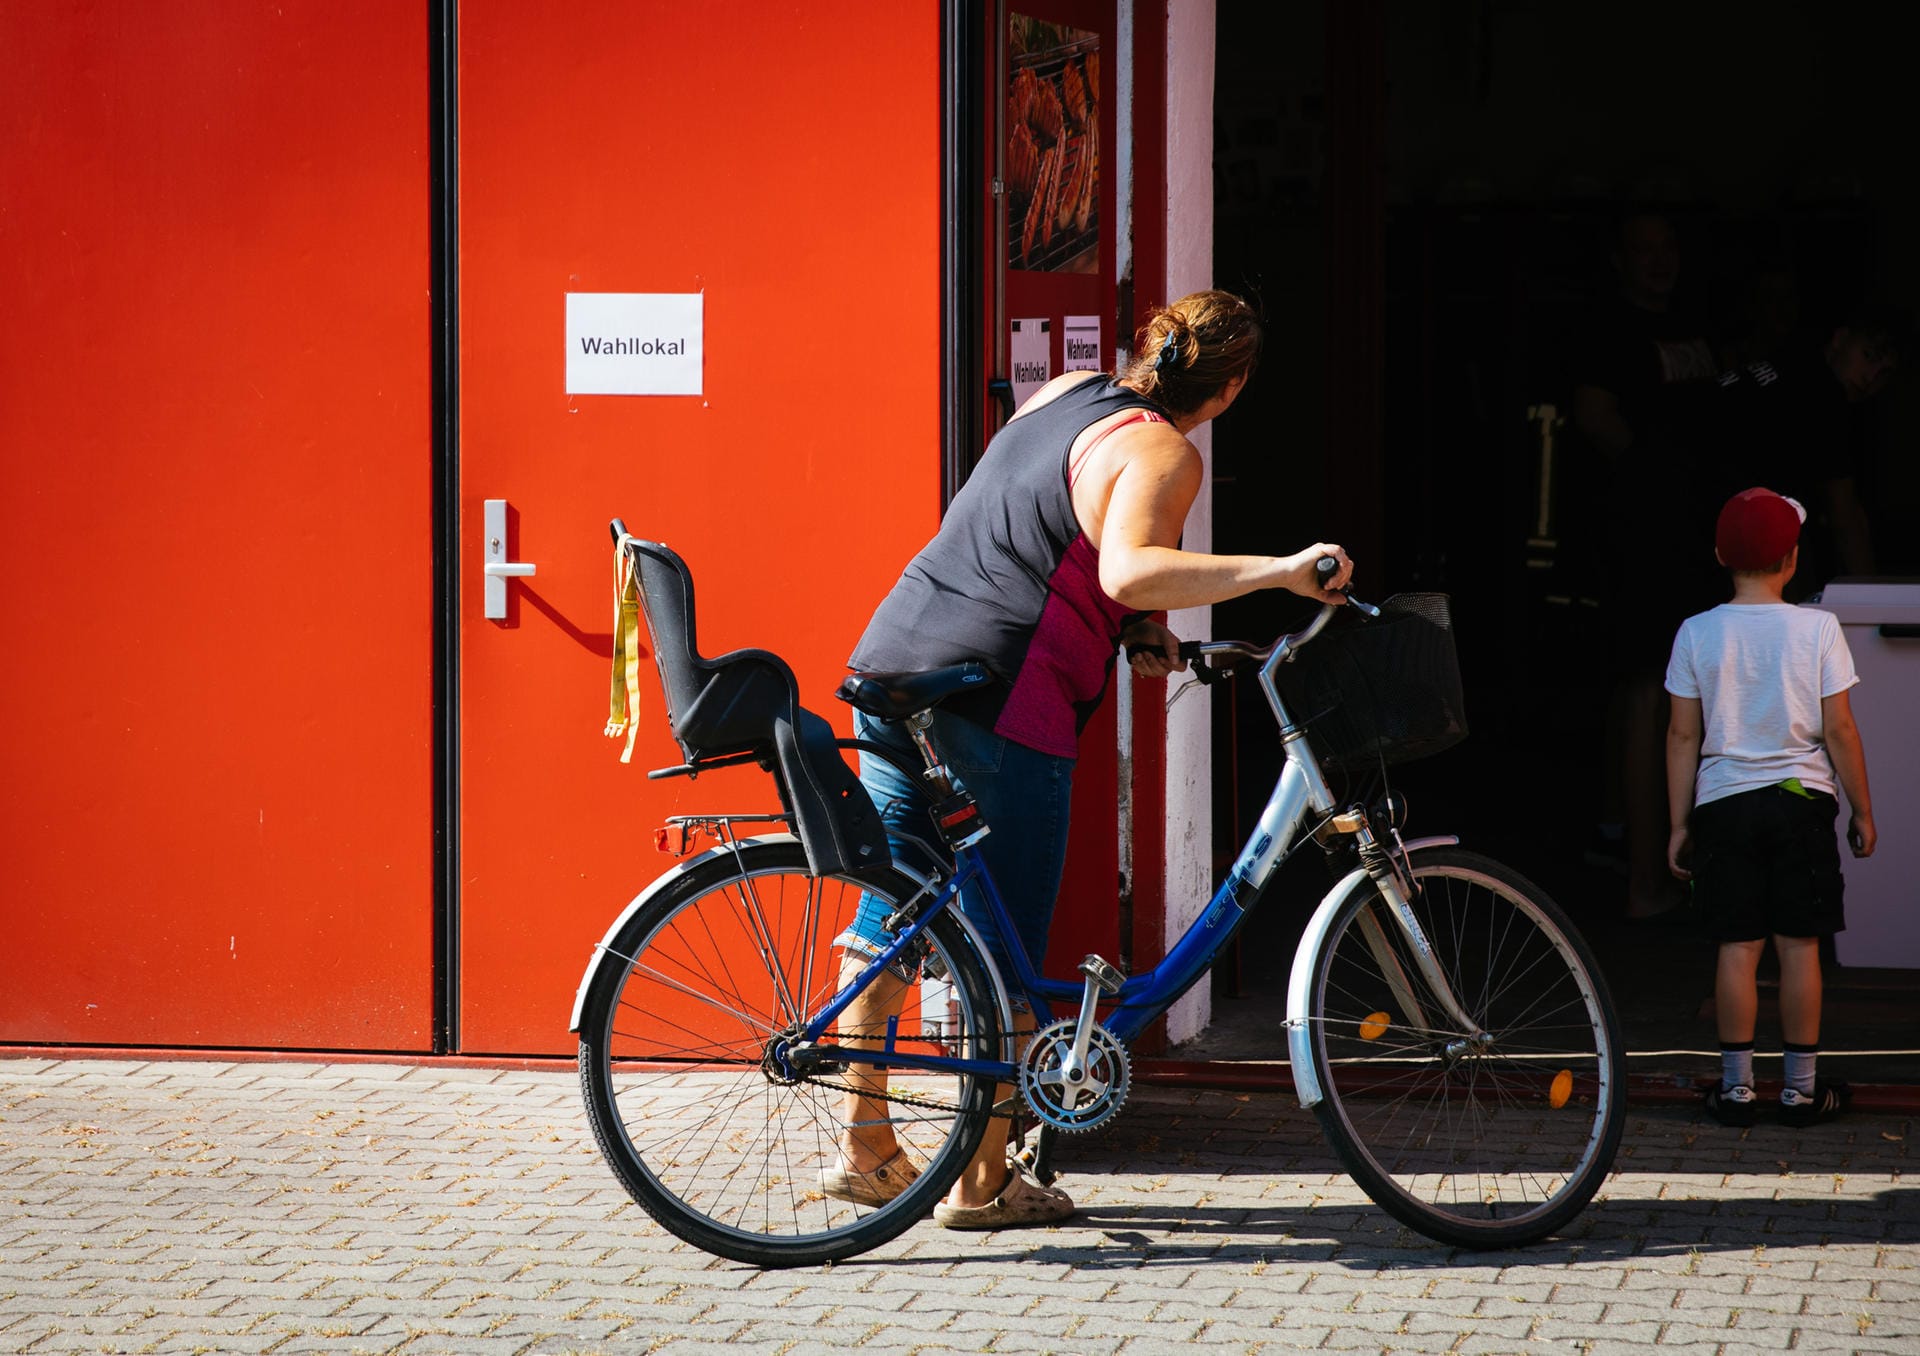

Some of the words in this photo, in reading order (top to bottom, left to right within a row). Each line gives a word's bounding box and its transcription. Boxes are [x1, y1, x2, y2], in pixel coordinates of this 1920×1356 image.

[581, 337, 685, 355] Wahllokal
[1066, 338, 1098, 360] Wahlraum
[1014, 361, 1047, 383] Wahllokal
